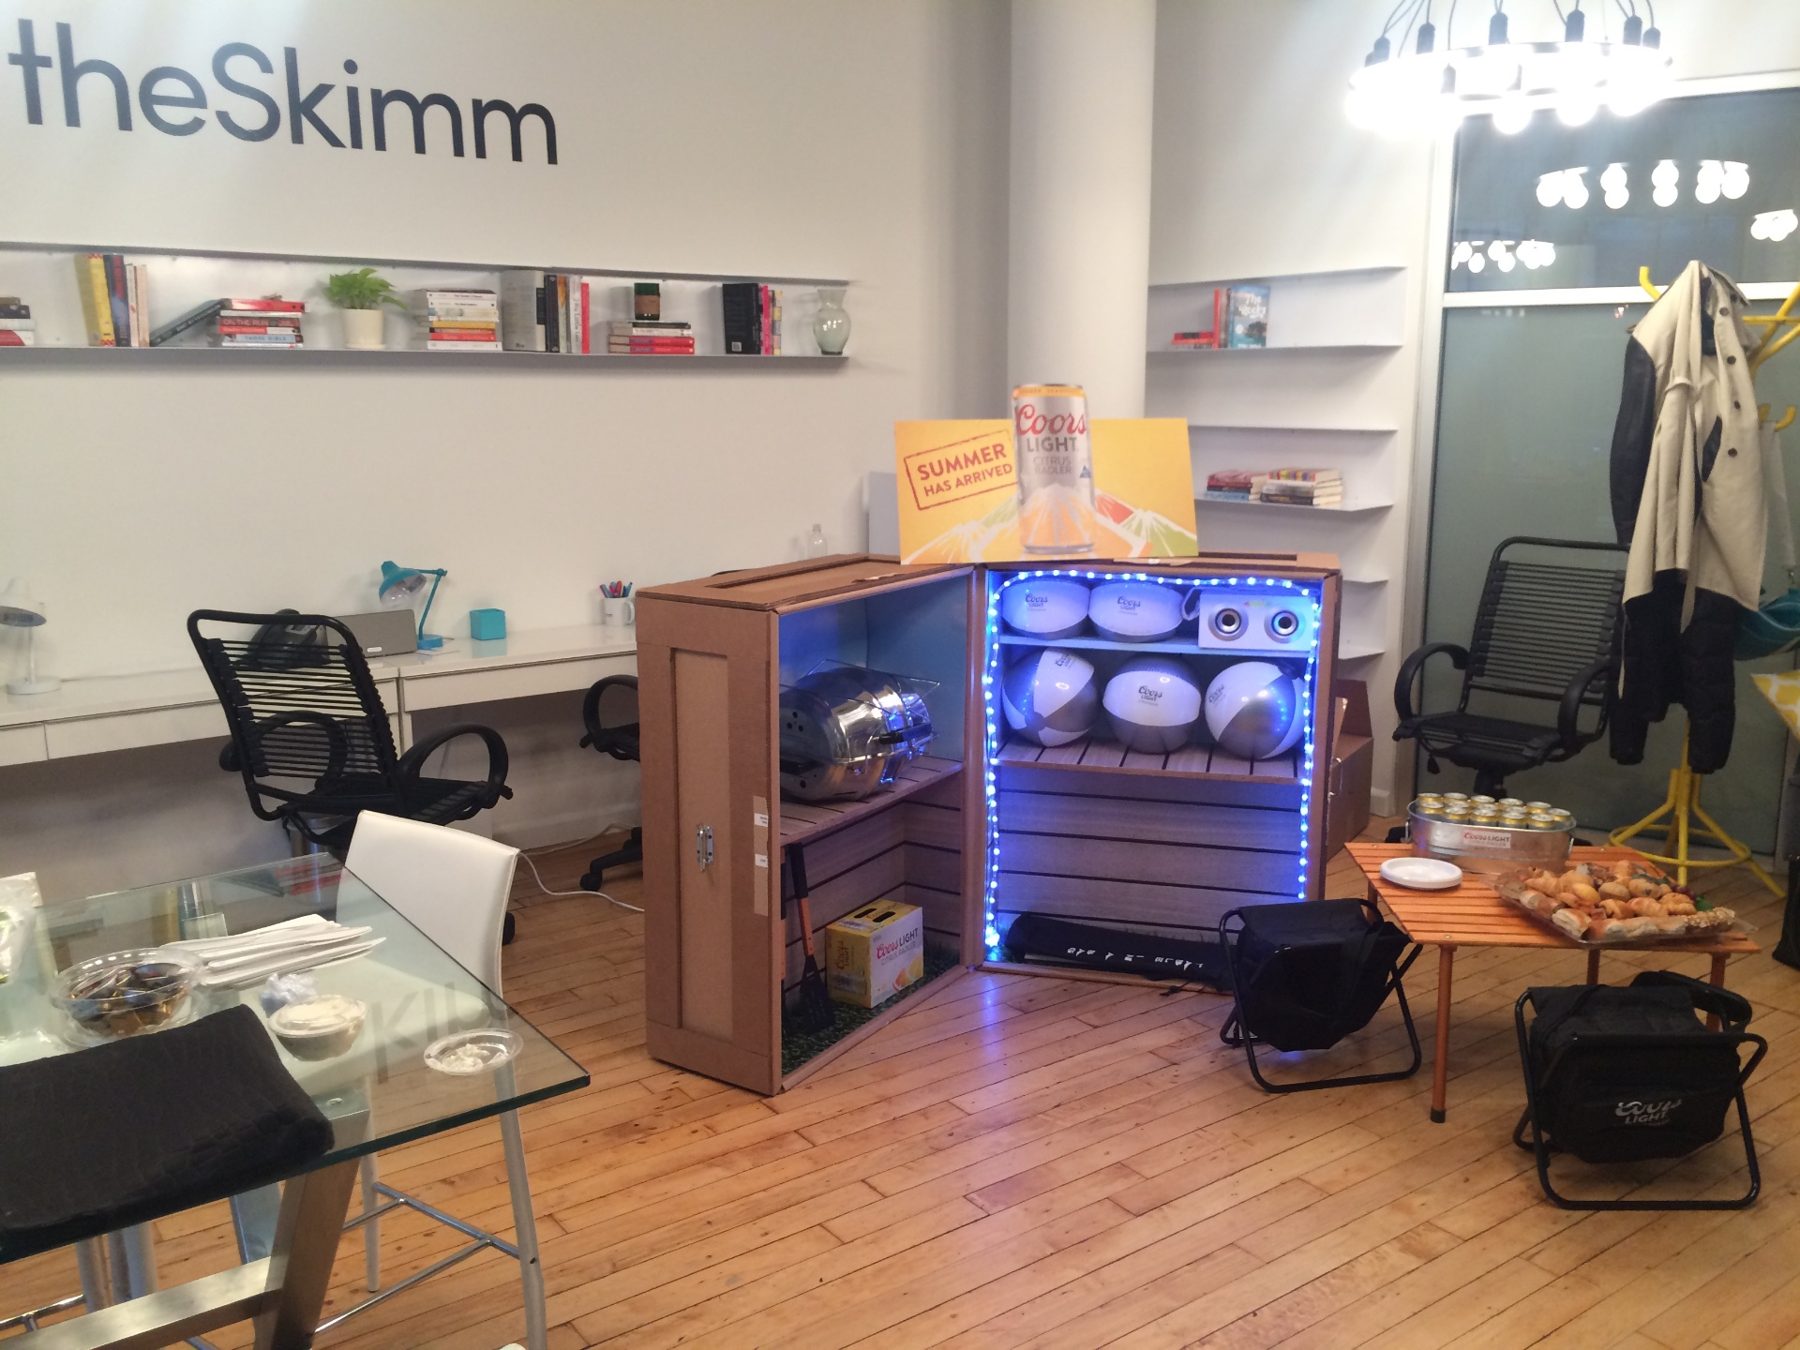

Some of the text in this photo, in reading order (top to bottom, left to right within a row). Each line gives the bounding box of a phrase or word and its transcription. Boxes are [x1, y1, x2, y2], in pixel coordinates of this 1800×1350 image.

[8, 18, 558, 165] theSkimm
[1015, 404, 1087, 435] Coors
[1026, 437, 1077, 452] LIGHT
[917, 443, 1007, 481] SUMMER
[1033, 456, 1072, 465] CITRUS
[923, 463, 1013, 497] HAS ARRIVED
[1138, 685, 1163, 698] Coors
[1488, 835, 1510, 843] LIGHT
[876, 940, 899, 959] Coors
[899, 928, 919, 946] LIGHT
